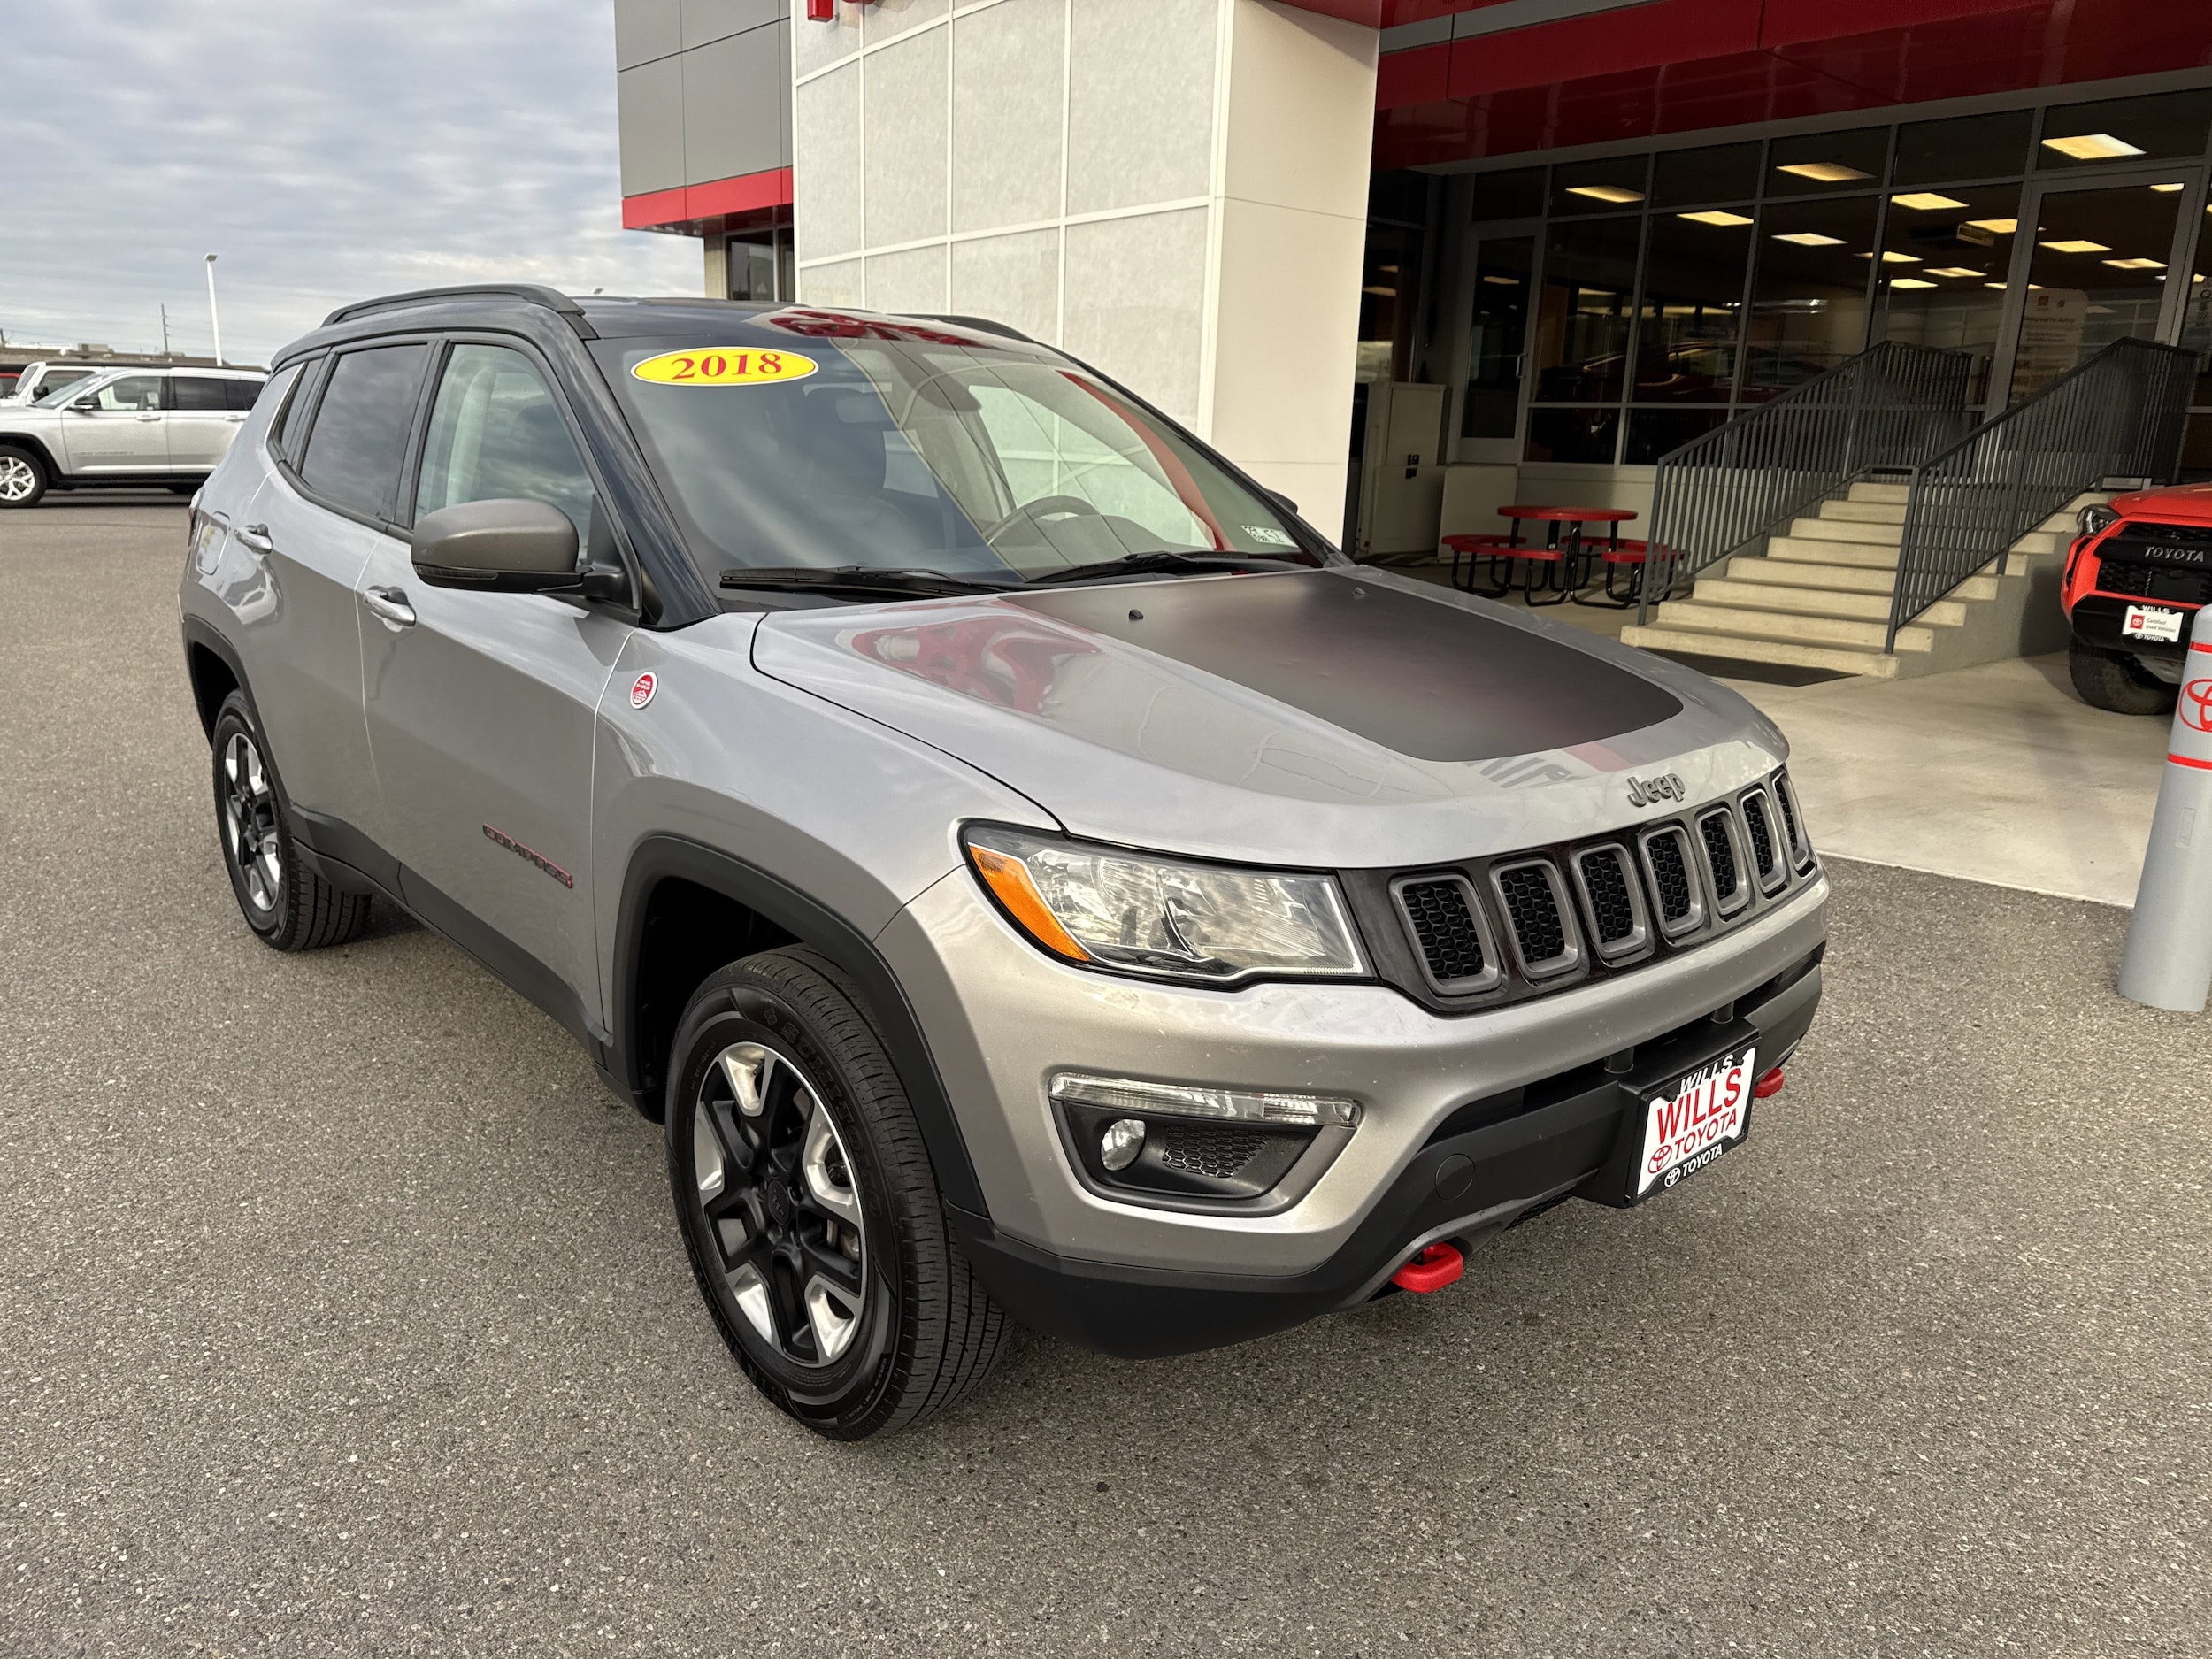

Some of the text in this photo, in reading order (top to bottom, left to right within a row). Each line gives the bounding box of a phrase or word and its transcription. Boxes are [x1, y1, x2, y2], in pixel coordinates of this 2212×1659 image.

[672, 354, 782, 380] 2018
[2145, 546, 2204, 562] TOYOTA
[2142, 604, 2170, 614] WILLS
[2144, 634, 2165, 642] TOYOTA
[1627, 772, 1686, 807] Jeep
[1681, 1054, 1734, 1093] WILLS
[780, 1020, 883, 1220] SUMITOMO
[1657, 1068, 1742, 1144] WILLS
[1675, 1108, 1738, 1160] TOYOTA
[1683, 1143, 1723, 1177] TOYOTA
